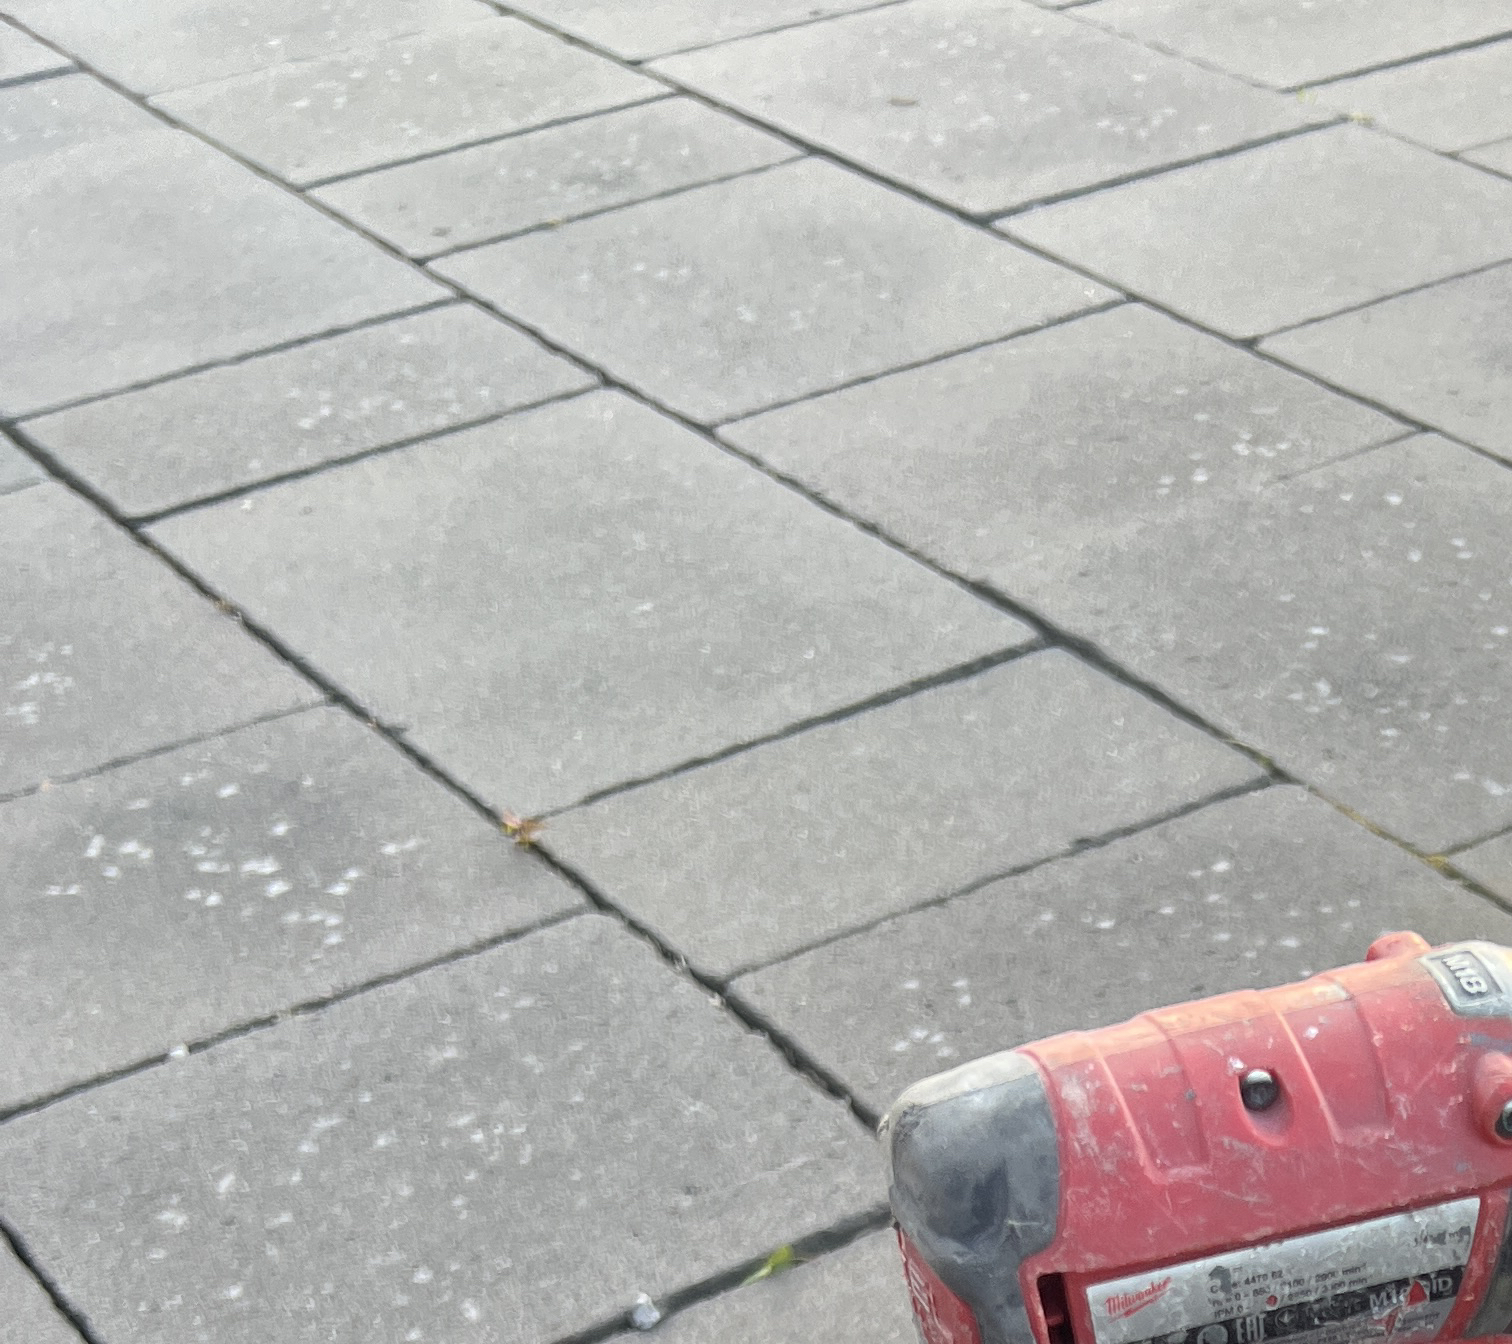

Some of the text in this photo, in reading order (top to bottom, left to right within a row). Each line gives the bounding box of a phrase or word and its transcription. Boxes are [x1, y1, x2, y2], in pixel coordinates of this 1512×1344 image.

[1441, 954, 1489, 994] M18
[1104, 1276, 1172, 1316] Milwaukee
[1210, 1281, 1241, 1294] Ce:
